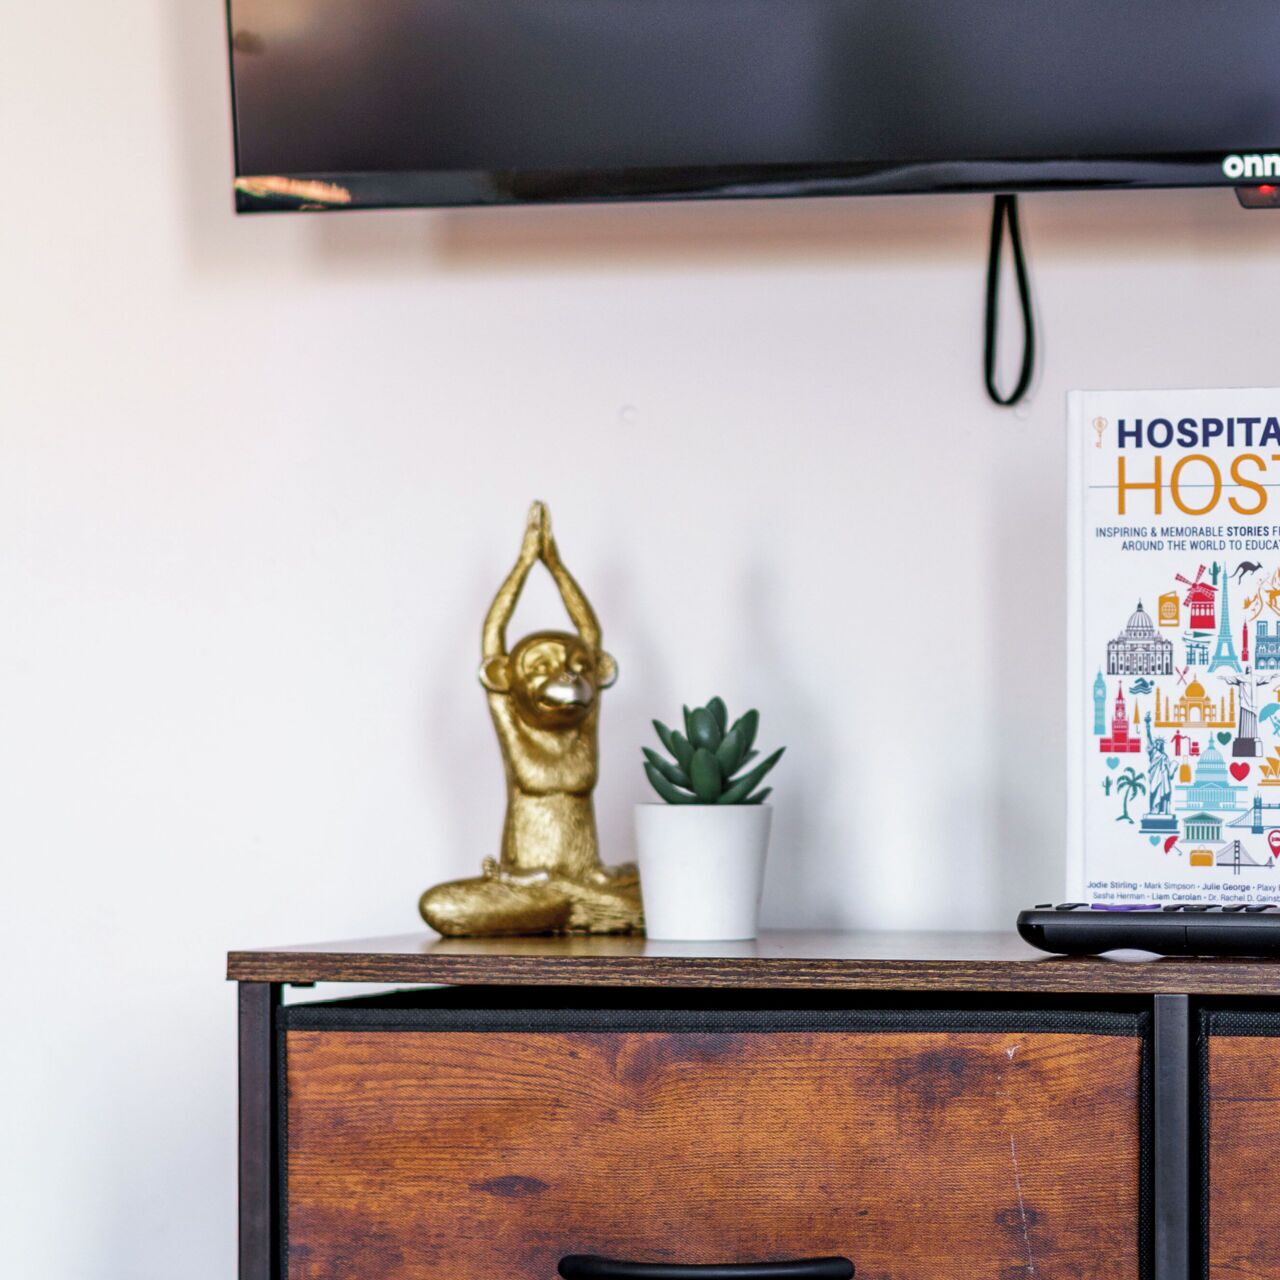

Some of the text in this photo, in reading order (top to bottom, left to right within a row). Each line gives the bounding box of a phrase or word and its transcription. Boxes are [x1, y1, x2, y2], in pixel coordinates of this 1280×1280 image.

[1095, 527, 1148, 538] INSPIRING
[1150, 527, 1158, 537] &
[1160, 526, 1224, 537] MEMORABLE
[1226, 526, 1270, 537] STORIES
[1121, 540, 1164, 551] AROUND
[1167, 540, 1187, 551] THE
[1189, 540, 1226, 551] WORLD
[1229, 539, 1242, 550] TO
[1087, 881, 1108, 889] Jodie
[1110, 881, 1138, 891] Stirling
[1163, 882, 1195, 891] Simpson
[1222, 883, 1251, 892] George
[1093, 892, 1115, 900] Sasha
[1116, 892, 1145, 900] Herman
[1151, 893, 1171, 901] Liam
[1172, 893, 1202, 901] Carolan
[1208, 893, 1219, 901] Dr.
[1220, 894, 1245, 902] Rachel
